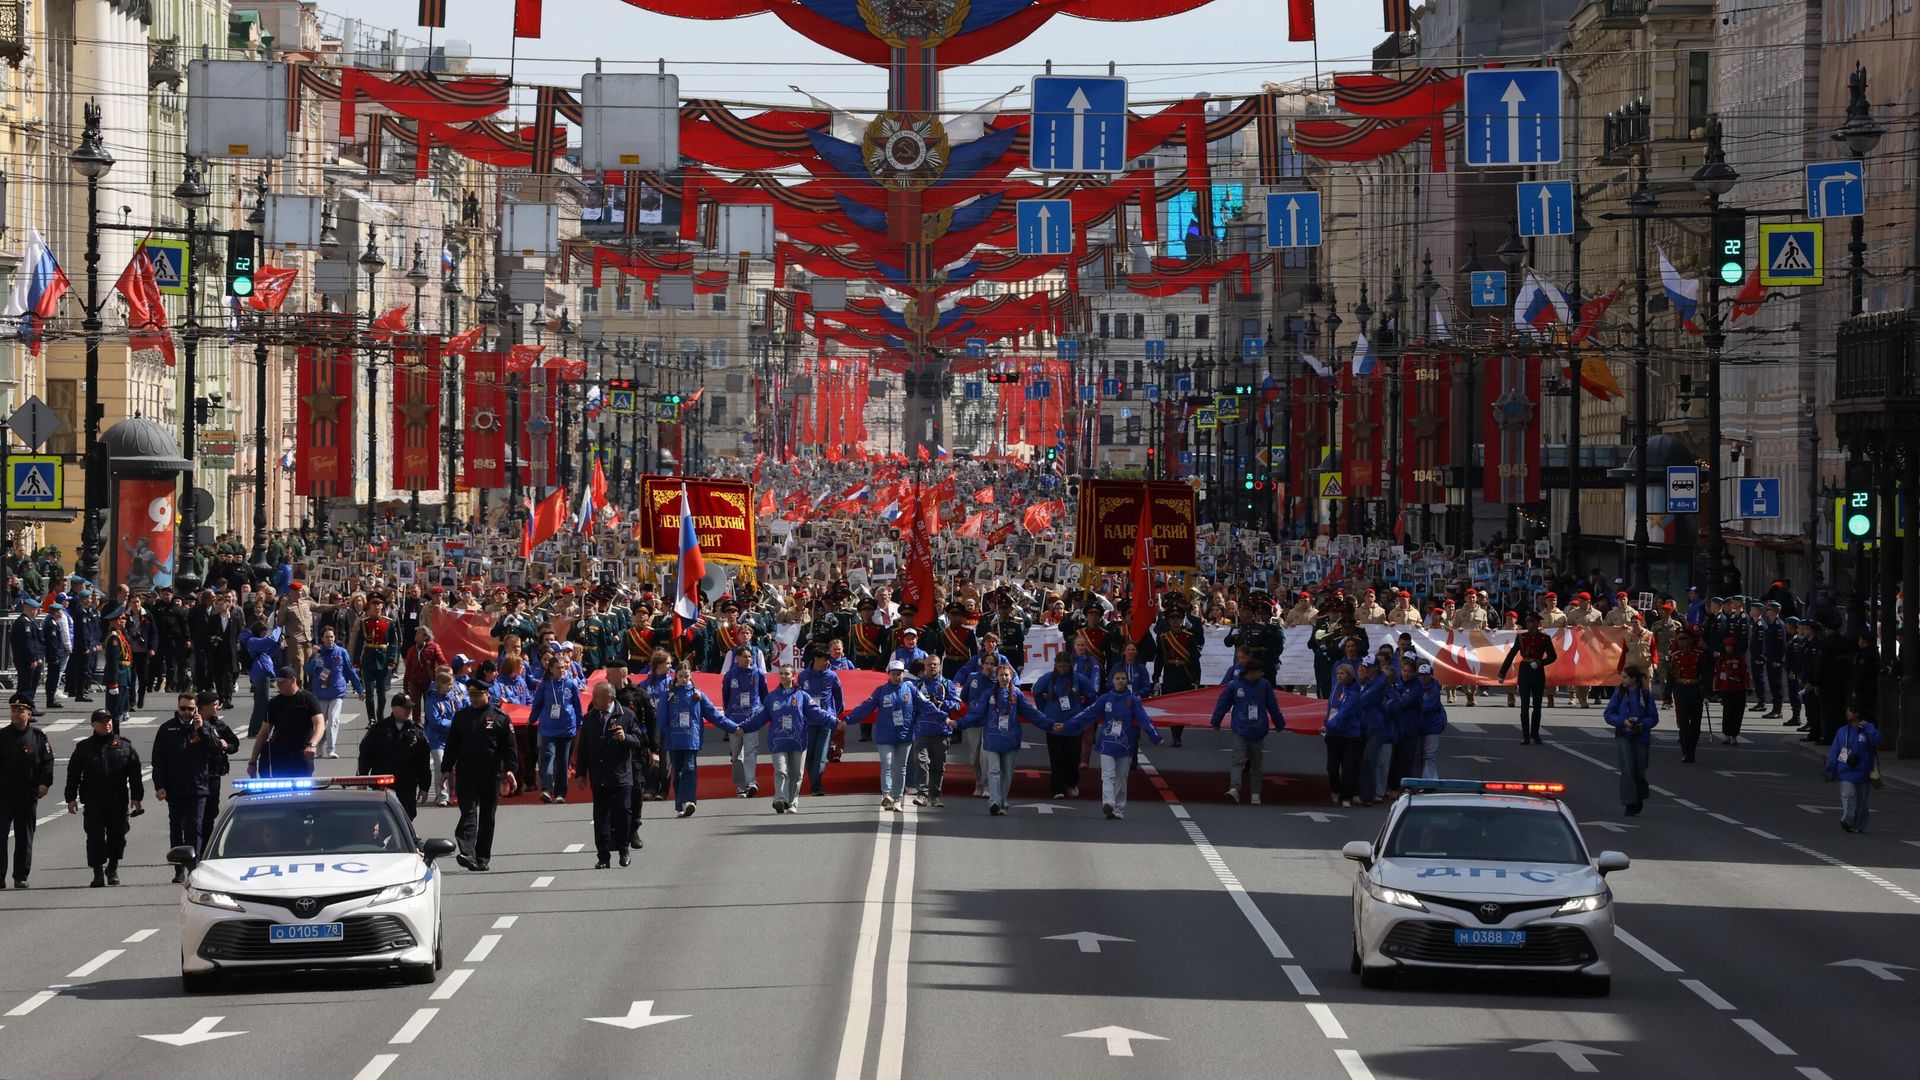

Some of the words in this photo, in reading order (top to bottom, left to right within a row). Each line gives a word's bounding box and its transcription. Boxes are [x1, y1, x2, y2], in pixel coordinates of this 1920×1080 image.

[1725, 240, 1741, 254] 22
[1414, 368, 1440, 381] 1941
[473, 458, 497, 470] 1945
[1497, 463, 1528, 477] 1945
[1852, 492, 1868, 507] 22
[148, 496, 172, 532] 9
[486, 721, 494, 729] Z
[239, 861, 369, 881] ДПС
[1417, 867, 1556, 883] ДПС
[288, 926, 319, 938] 0105
[326, 924, 338, 933] 78
[1472, 931, 1503, 943] 0388
[1511, 931, 1522, 941] 78
